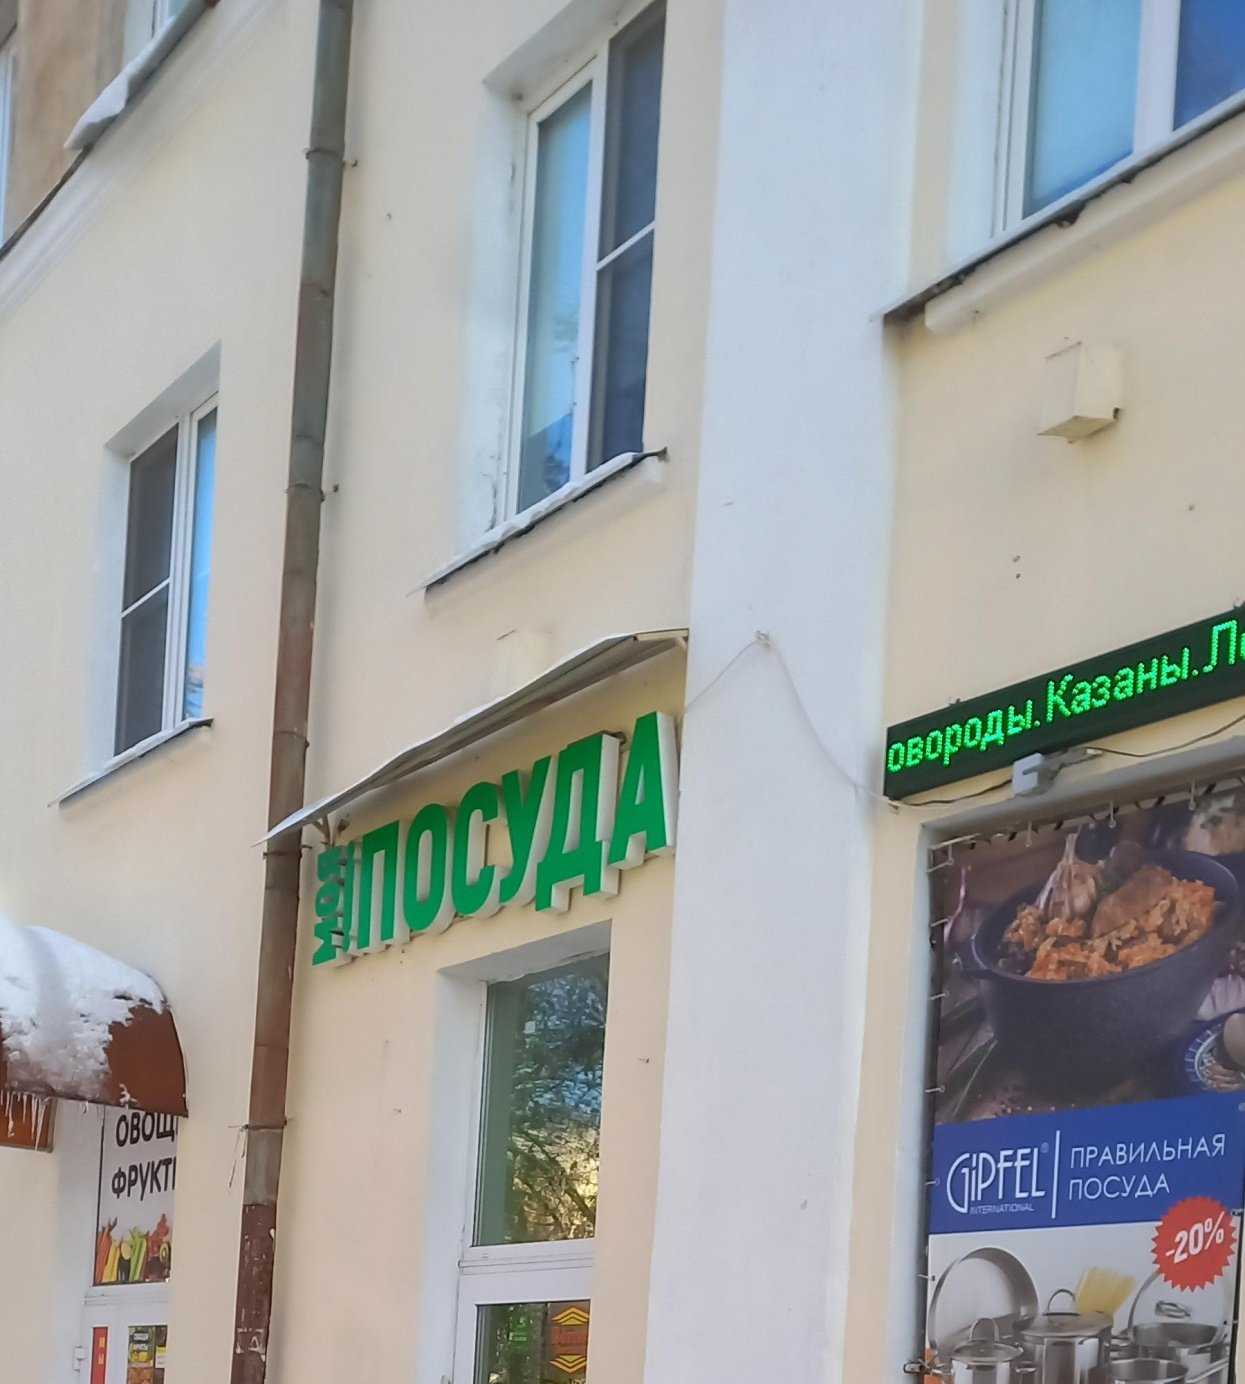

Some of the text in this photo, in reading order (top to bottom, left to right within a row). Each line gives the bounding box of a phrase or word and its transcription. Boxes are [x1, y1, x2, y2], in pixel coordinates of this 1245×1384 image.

[887, 619, 1245, 773] овороды.Казаны.Л
[312, 711, 672, 966] МОЯ ПОСУДА
[116, 1111, 178, 1147] ОВОЩ
[1070, 1132, 1226, 1169] ПРАВИЛЬНАЯ
[1068, 1173, 1170, 1201] ПОСУДА
[1165, 1211, 1226, 1264] -20%
